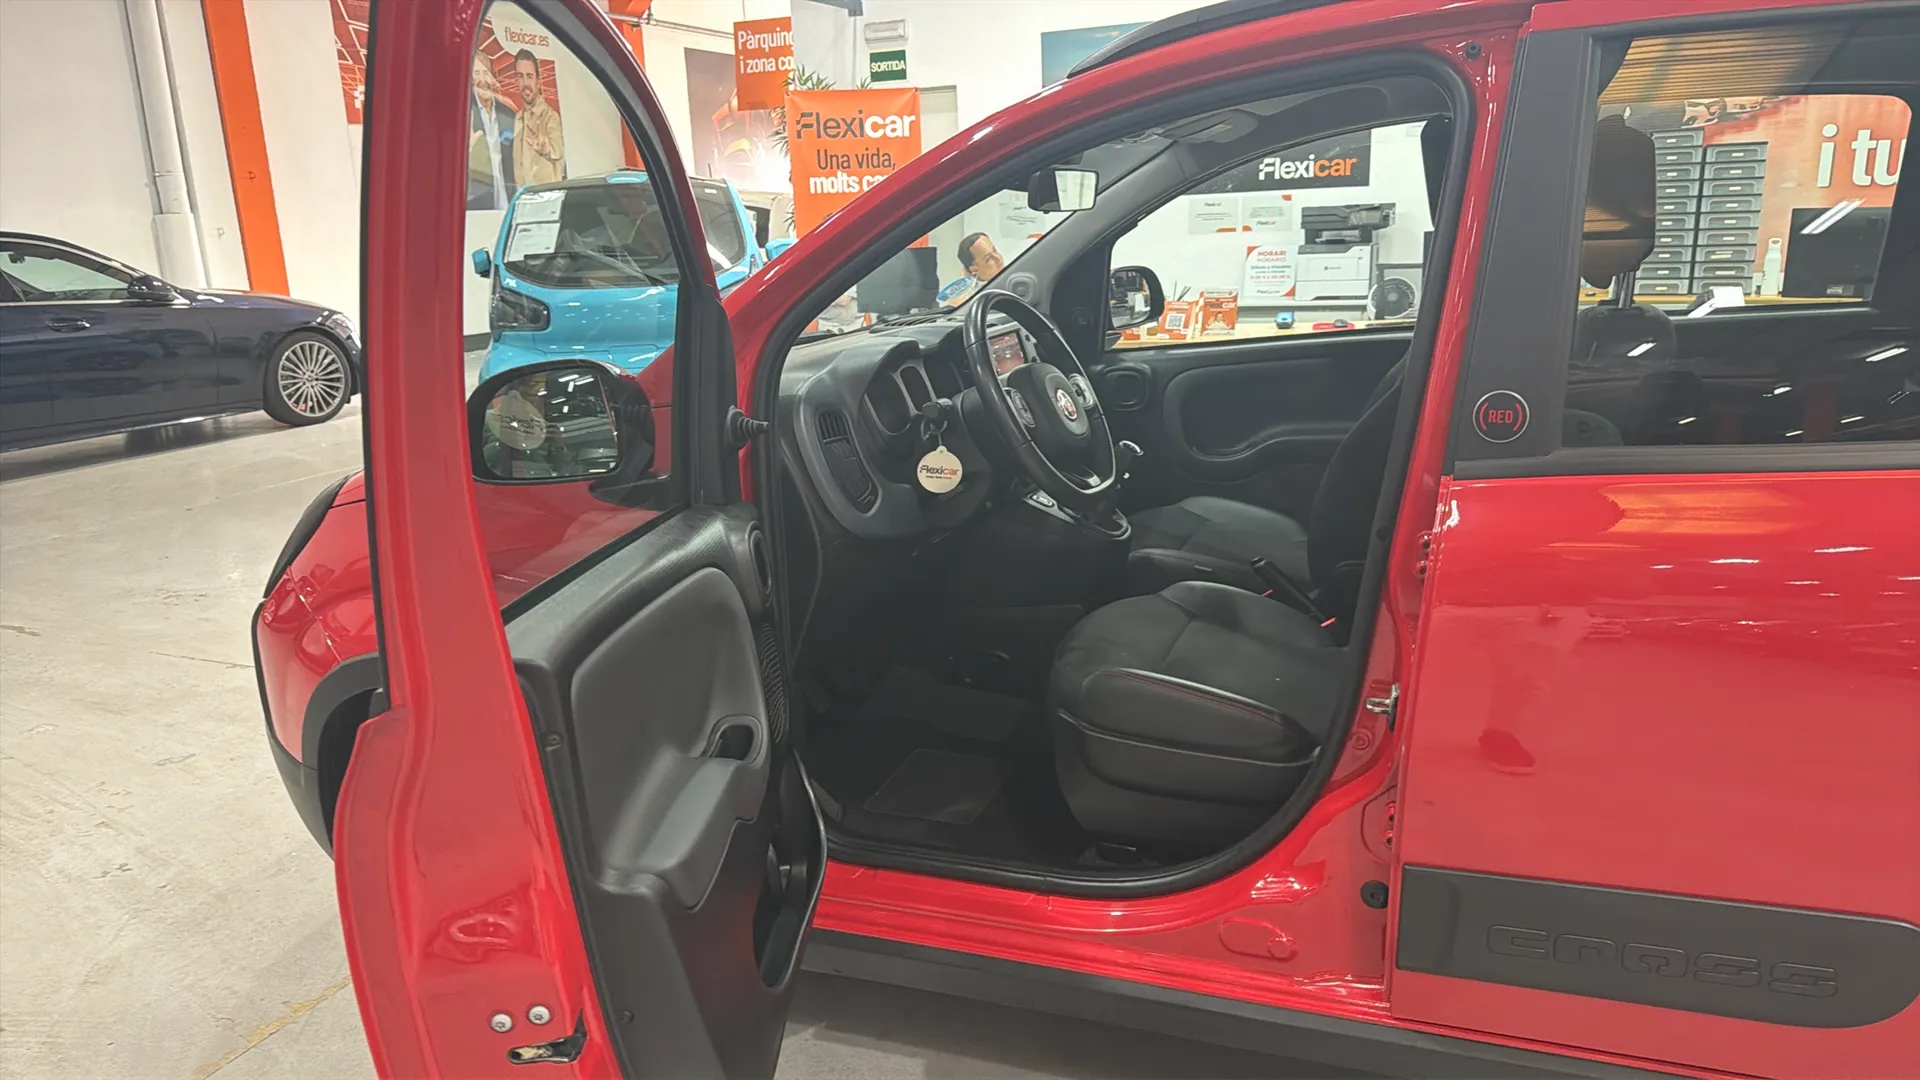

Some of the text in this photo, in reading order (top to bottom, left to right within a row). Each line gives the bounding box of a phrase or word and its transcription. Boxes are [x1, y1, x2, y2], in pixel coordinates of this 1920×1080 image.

[739, 55, 744, 74] i
[746, 57, 776, 73] zona
[870, 60, 906, 73] SORTIDA
[796, 109, 916, 139] Flexicar
[817, 147, 896, 171] Una vida,
[1258, 153, 1357, 180] Flexicar
[1817, 123, 1838, 188] i
[809, 171, 860, 194] molts
[919, 464, 960, 476] Flexicar
